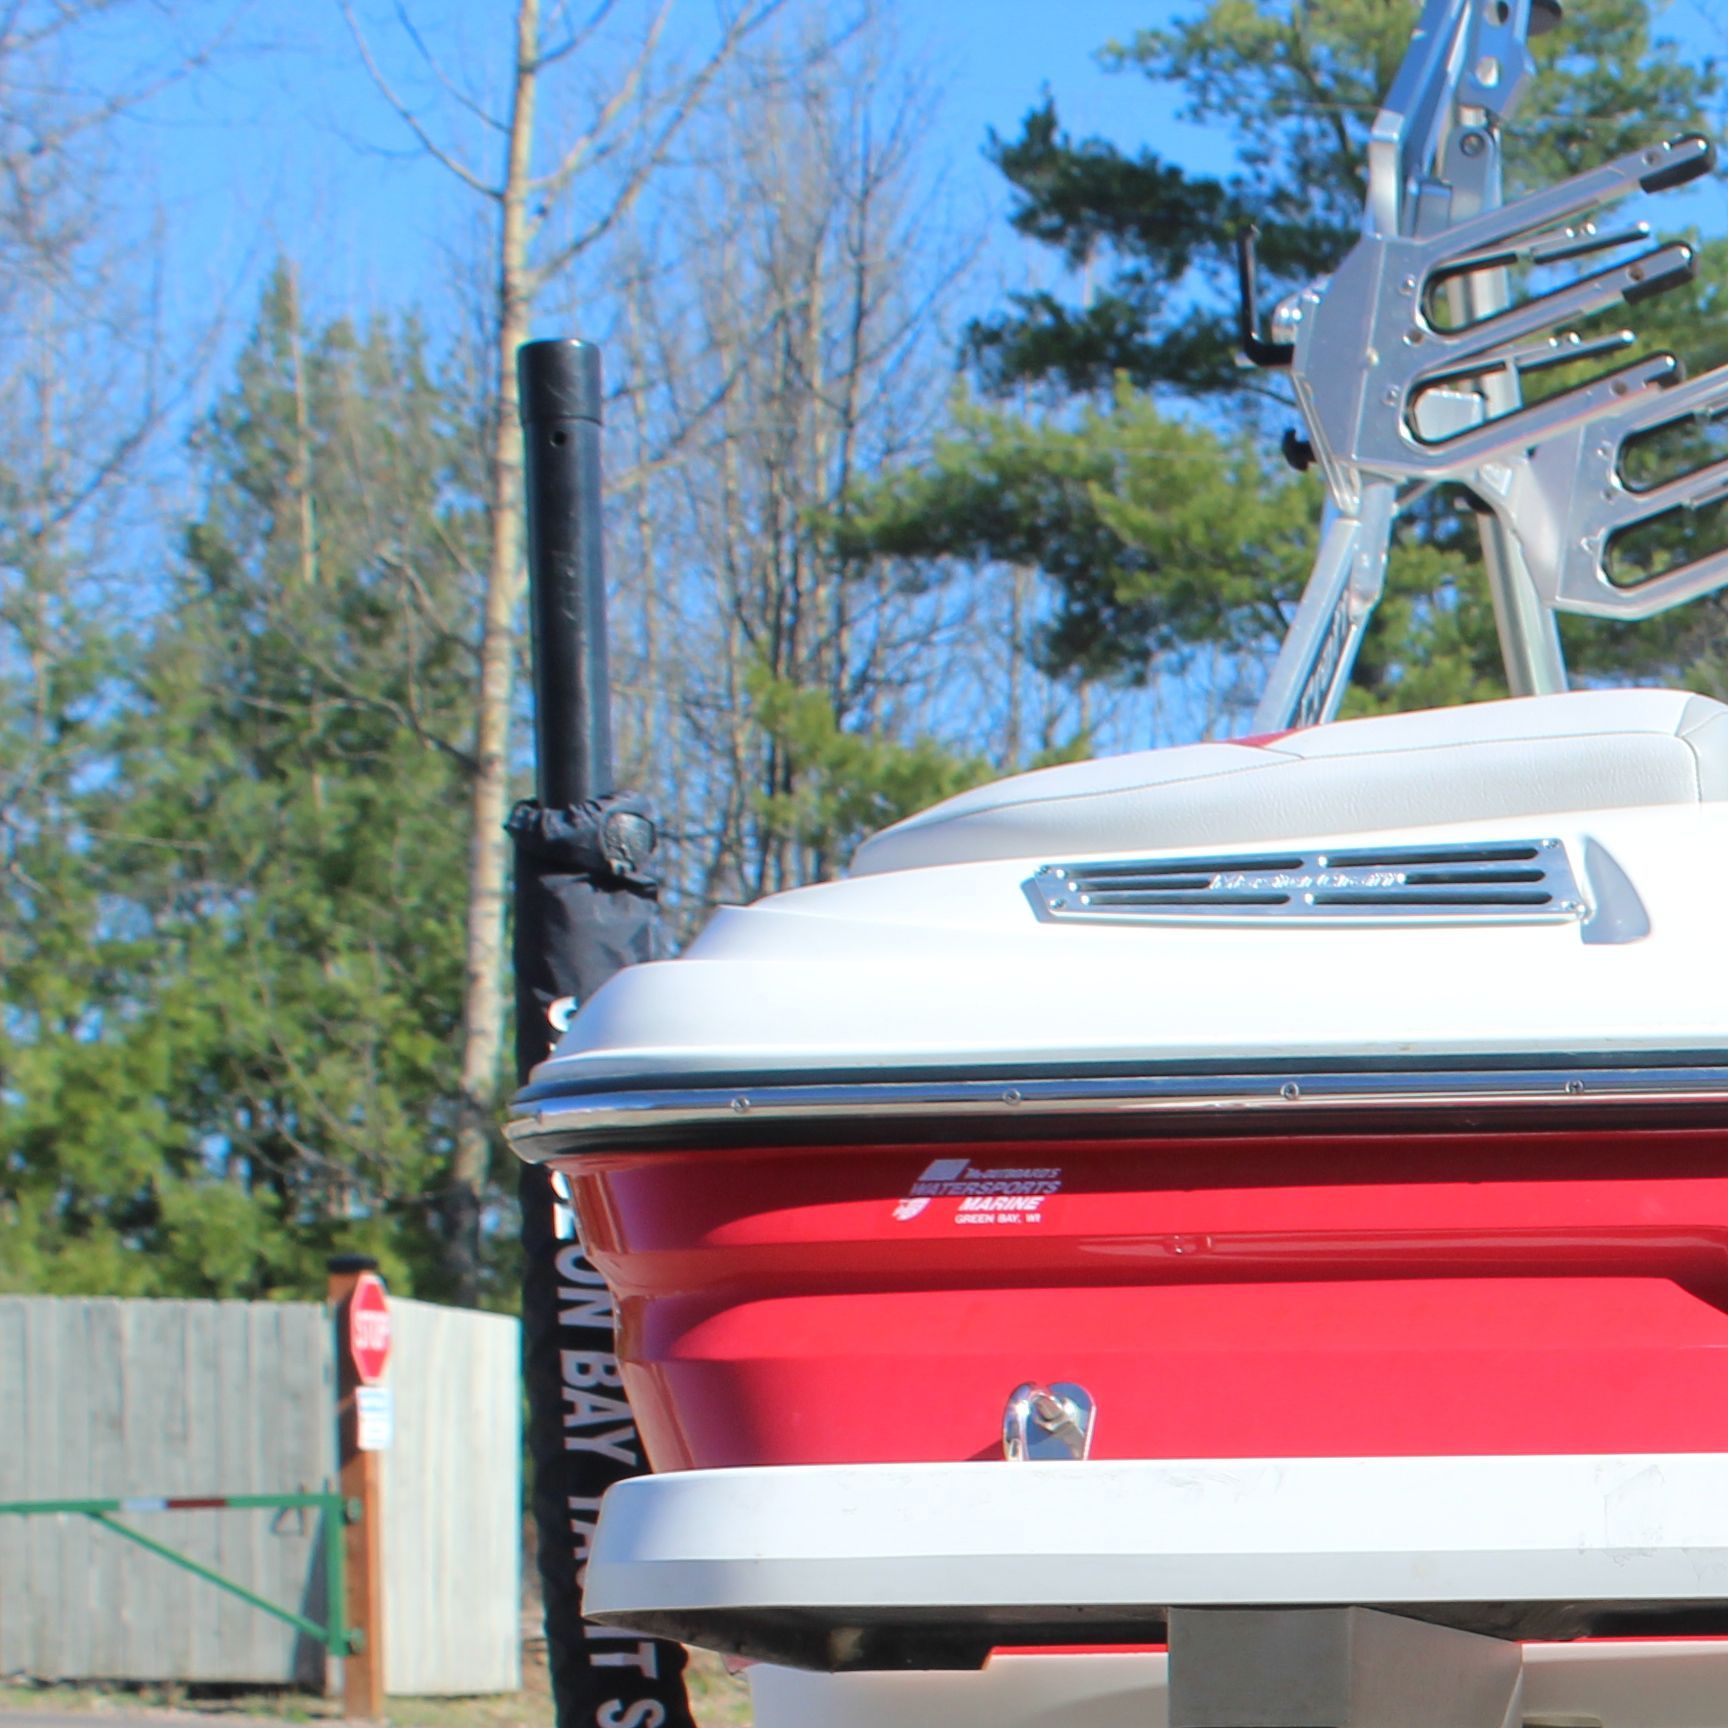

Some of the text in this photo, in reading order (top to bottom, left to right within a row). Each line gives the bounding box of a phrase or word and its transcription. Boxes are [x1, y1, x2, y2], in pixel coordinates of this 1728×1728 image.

[910, 1181, 1062, 1196] WATERSPORTS
[957, 1196, 1045, 1211] MARINE
[954, 1213, 995, 1224] GREEN
[1025, 1213, 1041, 1223] WI
[560, 1349, 638, 1467] BAY
